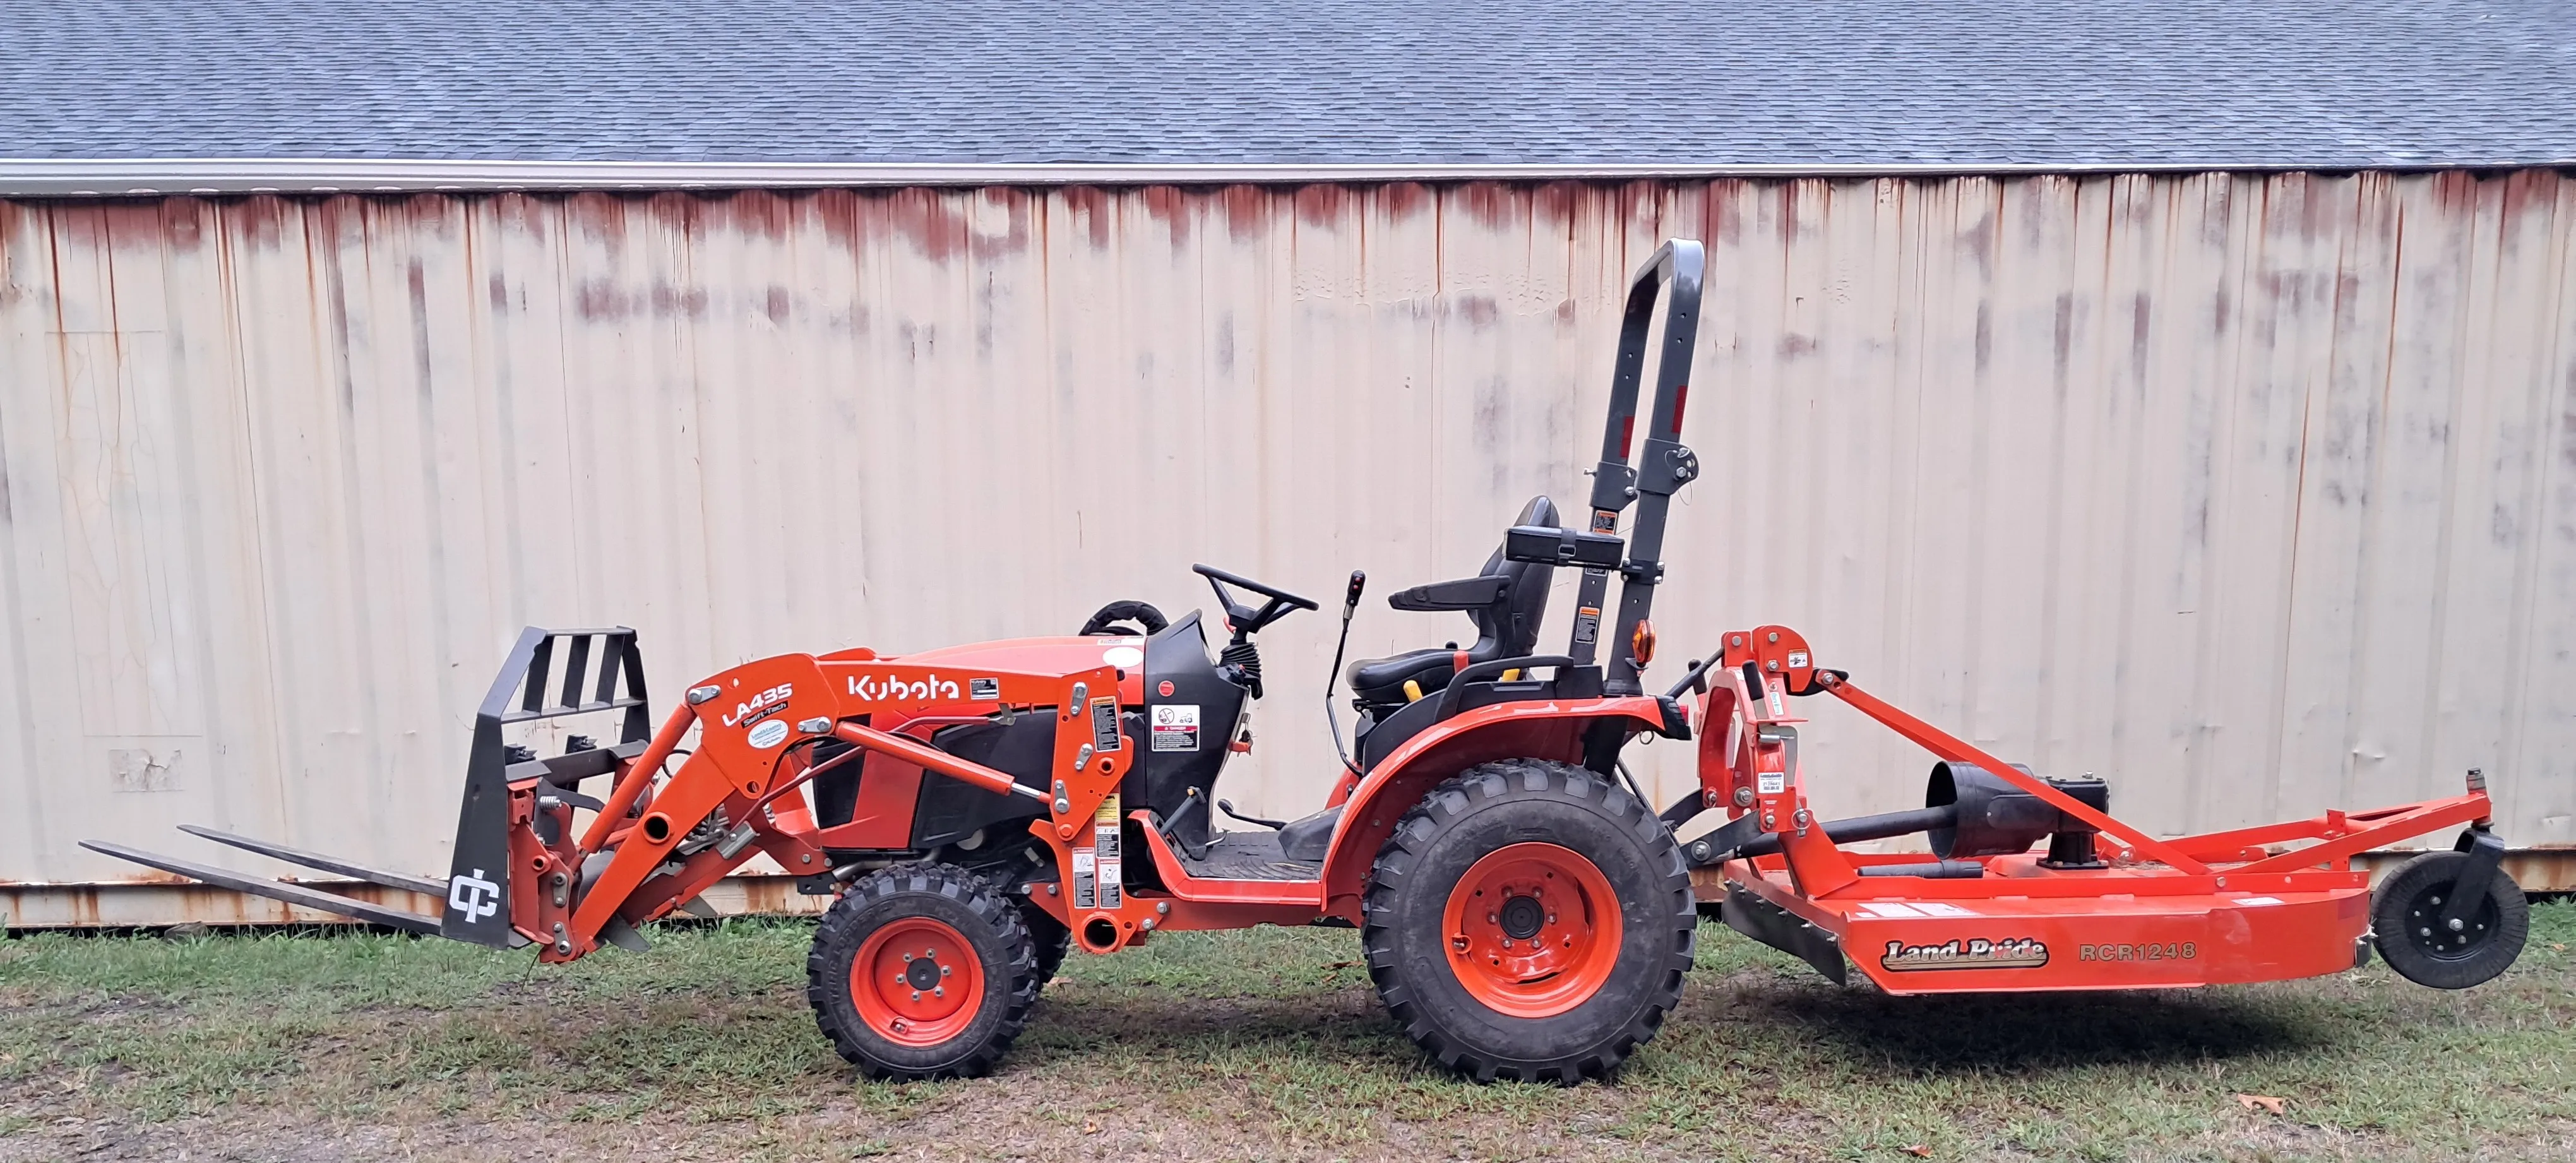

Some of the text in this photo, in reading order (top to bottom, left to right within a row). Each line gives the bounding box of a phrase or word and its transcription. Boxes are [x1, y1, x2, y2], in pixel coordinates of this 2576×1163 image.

[848, 674, 959, 701] Kubota
[722, 683, 792, 727] LA435
[743, 703, 787, 727] Swift-Tach
[1885, 939, 2044, 962] Land Pride
[2079, 941, 2197, 961] RCR1248
